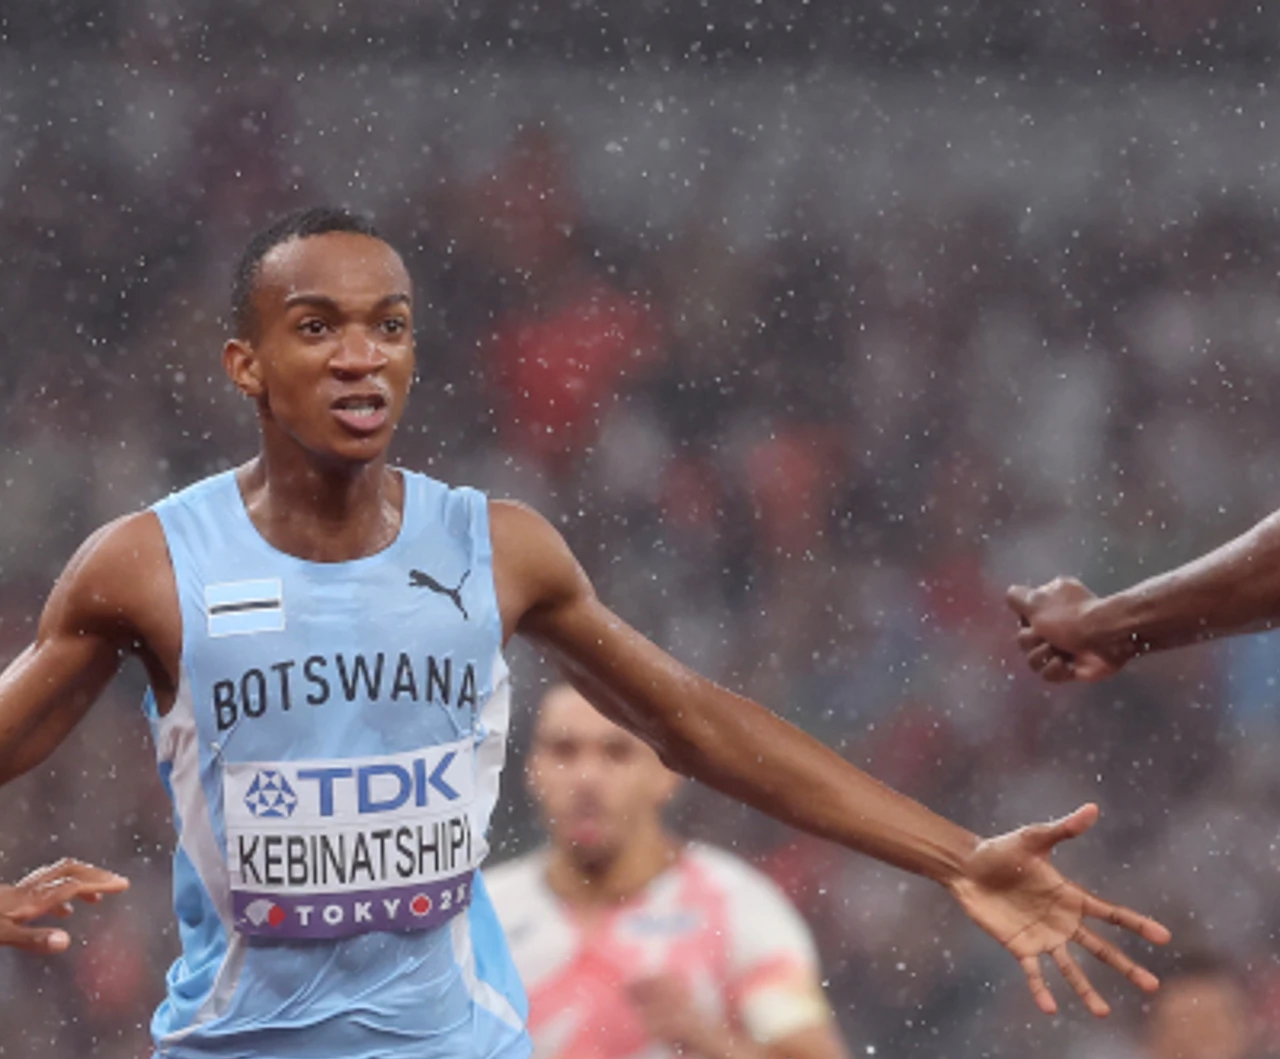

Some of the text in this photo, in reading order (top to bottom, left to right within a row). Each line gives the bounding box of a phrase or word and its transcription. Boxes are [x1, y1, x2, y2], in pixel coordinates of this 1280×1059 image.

[212, 652, 477, 732] BOTSWANA
[296, 751, 462, 818] TDK
[238, 813, 472, 887] KEBINATSHIPI
